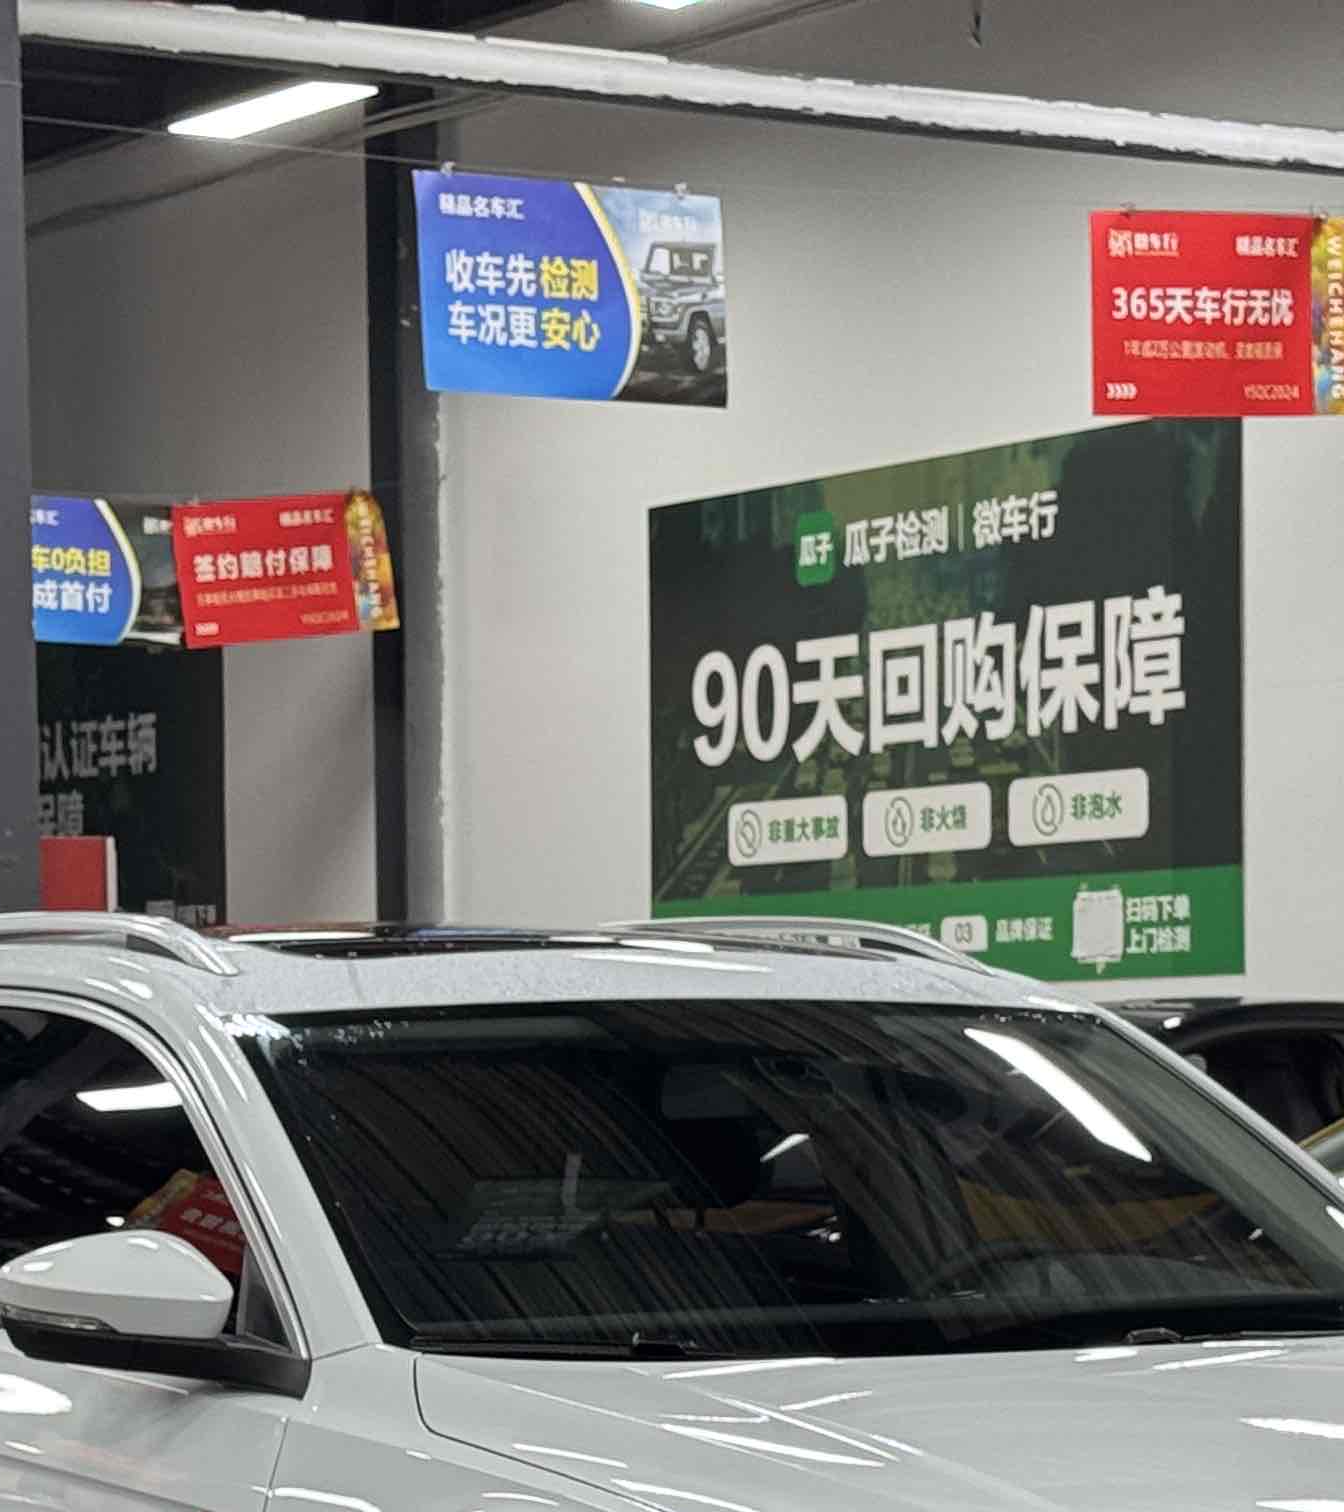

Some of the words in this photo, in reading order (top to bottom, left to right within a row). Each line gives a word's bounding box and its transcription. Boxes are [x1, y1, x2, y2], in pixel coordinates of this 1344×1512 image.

[439, 193, 525, 220] 精品名车汇
[444, 248, 599, 301] 收车先检测
[447, 300, 601, 352] 车况更安心
[1111, 286, 1295, 326] 365天车行无忧
[843, 505, 949, 568] 瓜子检测
[972, 490, 1059, 547] 微车行
[193, 544, 334, 583] 签约赔付保障
[691, 585, 1187, 767] 90天回购保障
[920, 801, 968, 834] 非火烧
[954, 920, 974, 945] 03
